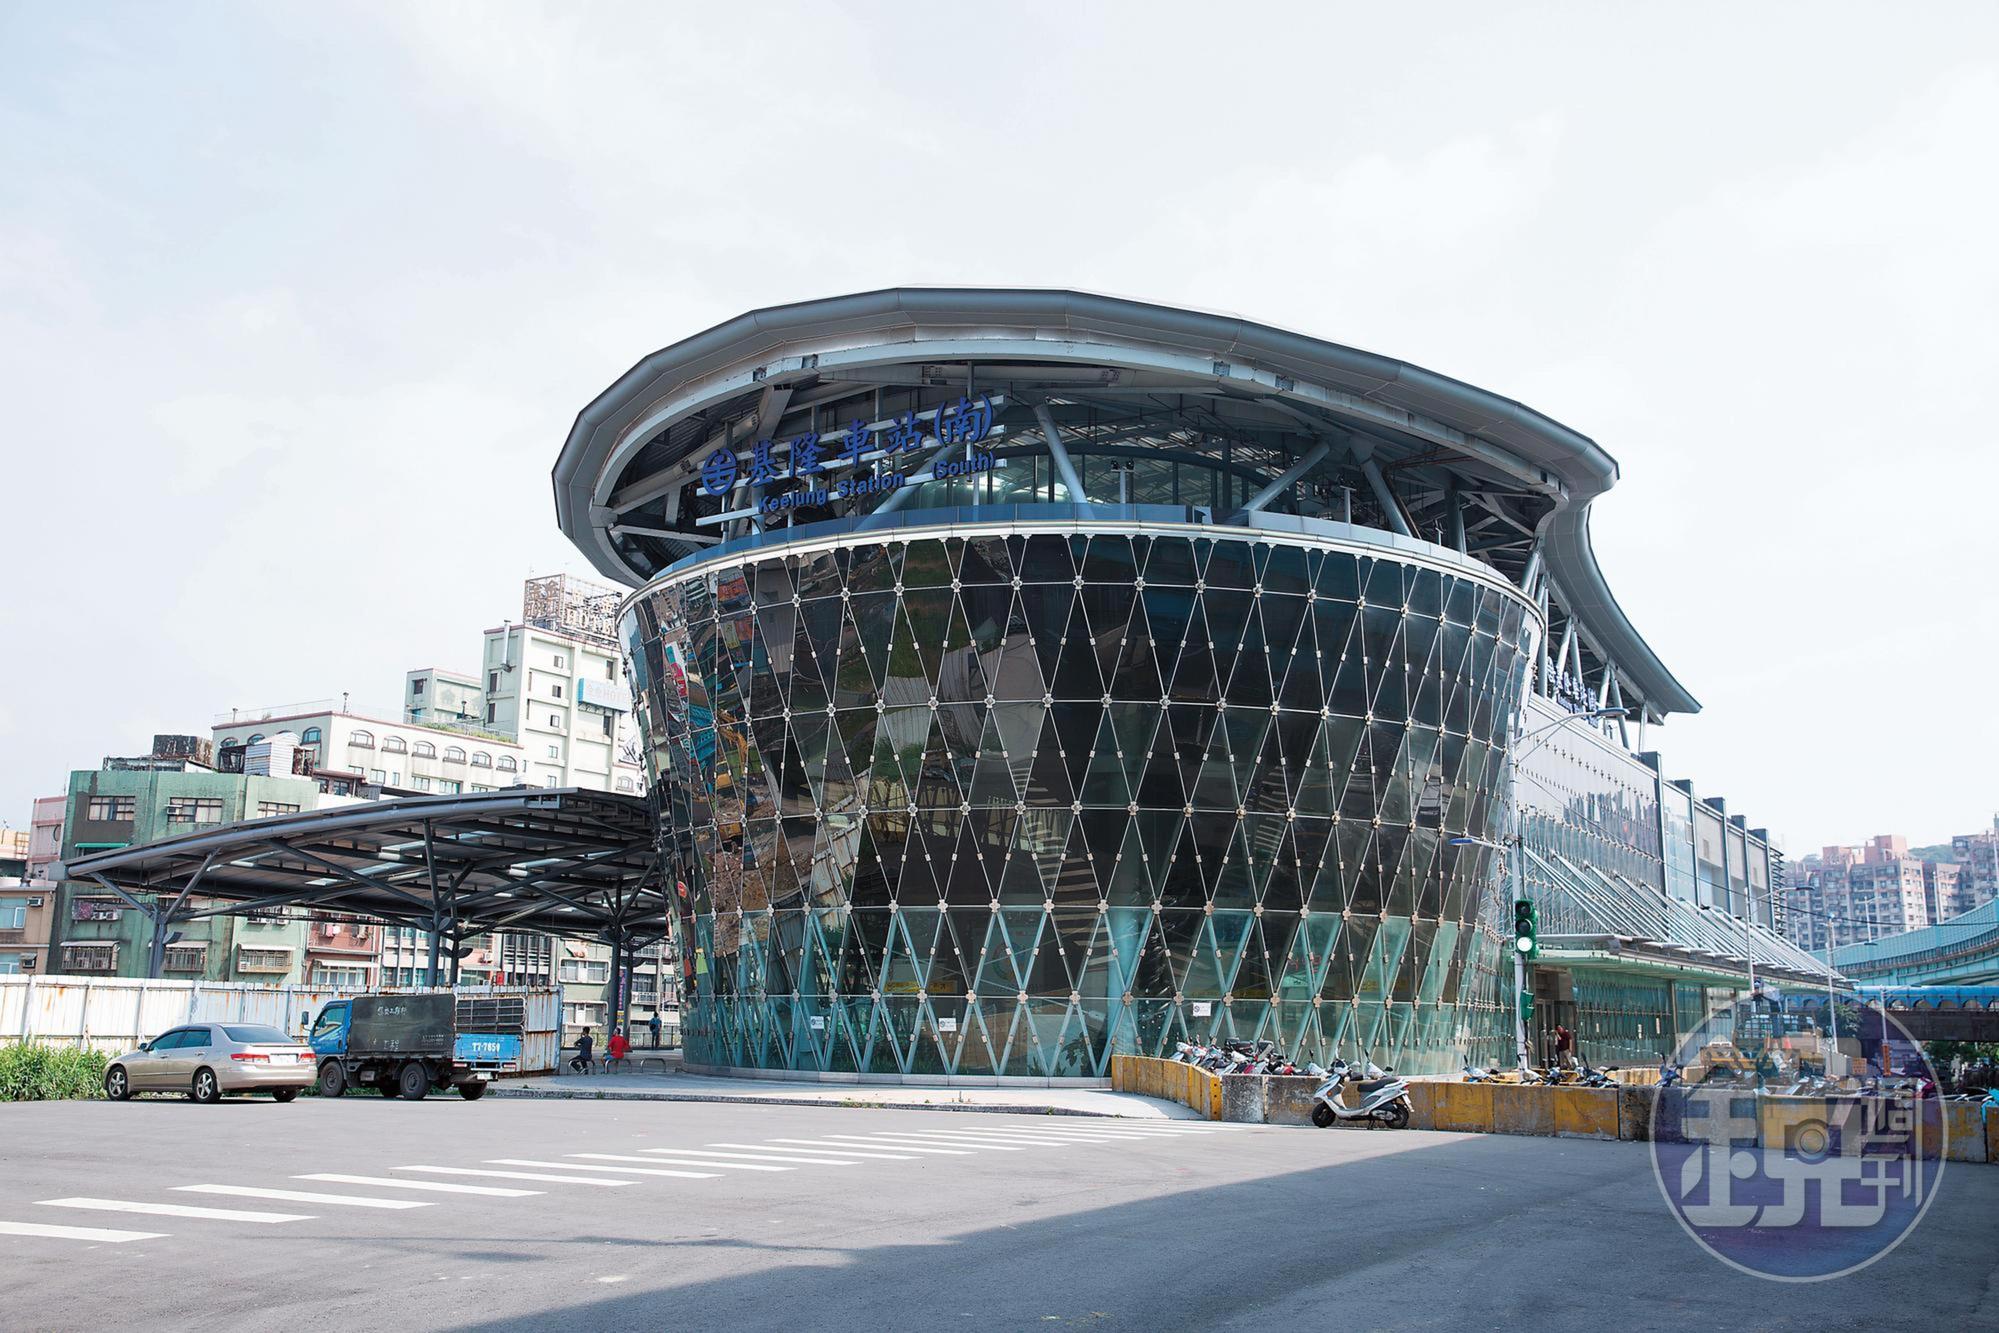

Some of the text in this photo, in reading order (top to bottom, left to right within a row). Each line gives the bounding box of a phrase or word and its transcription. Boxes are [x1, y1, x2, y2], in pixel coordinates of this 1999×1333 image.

[745, 393, 993, 488] 基隆車站(南)
[758, 450, 996, 514] Keelung Station (South)
